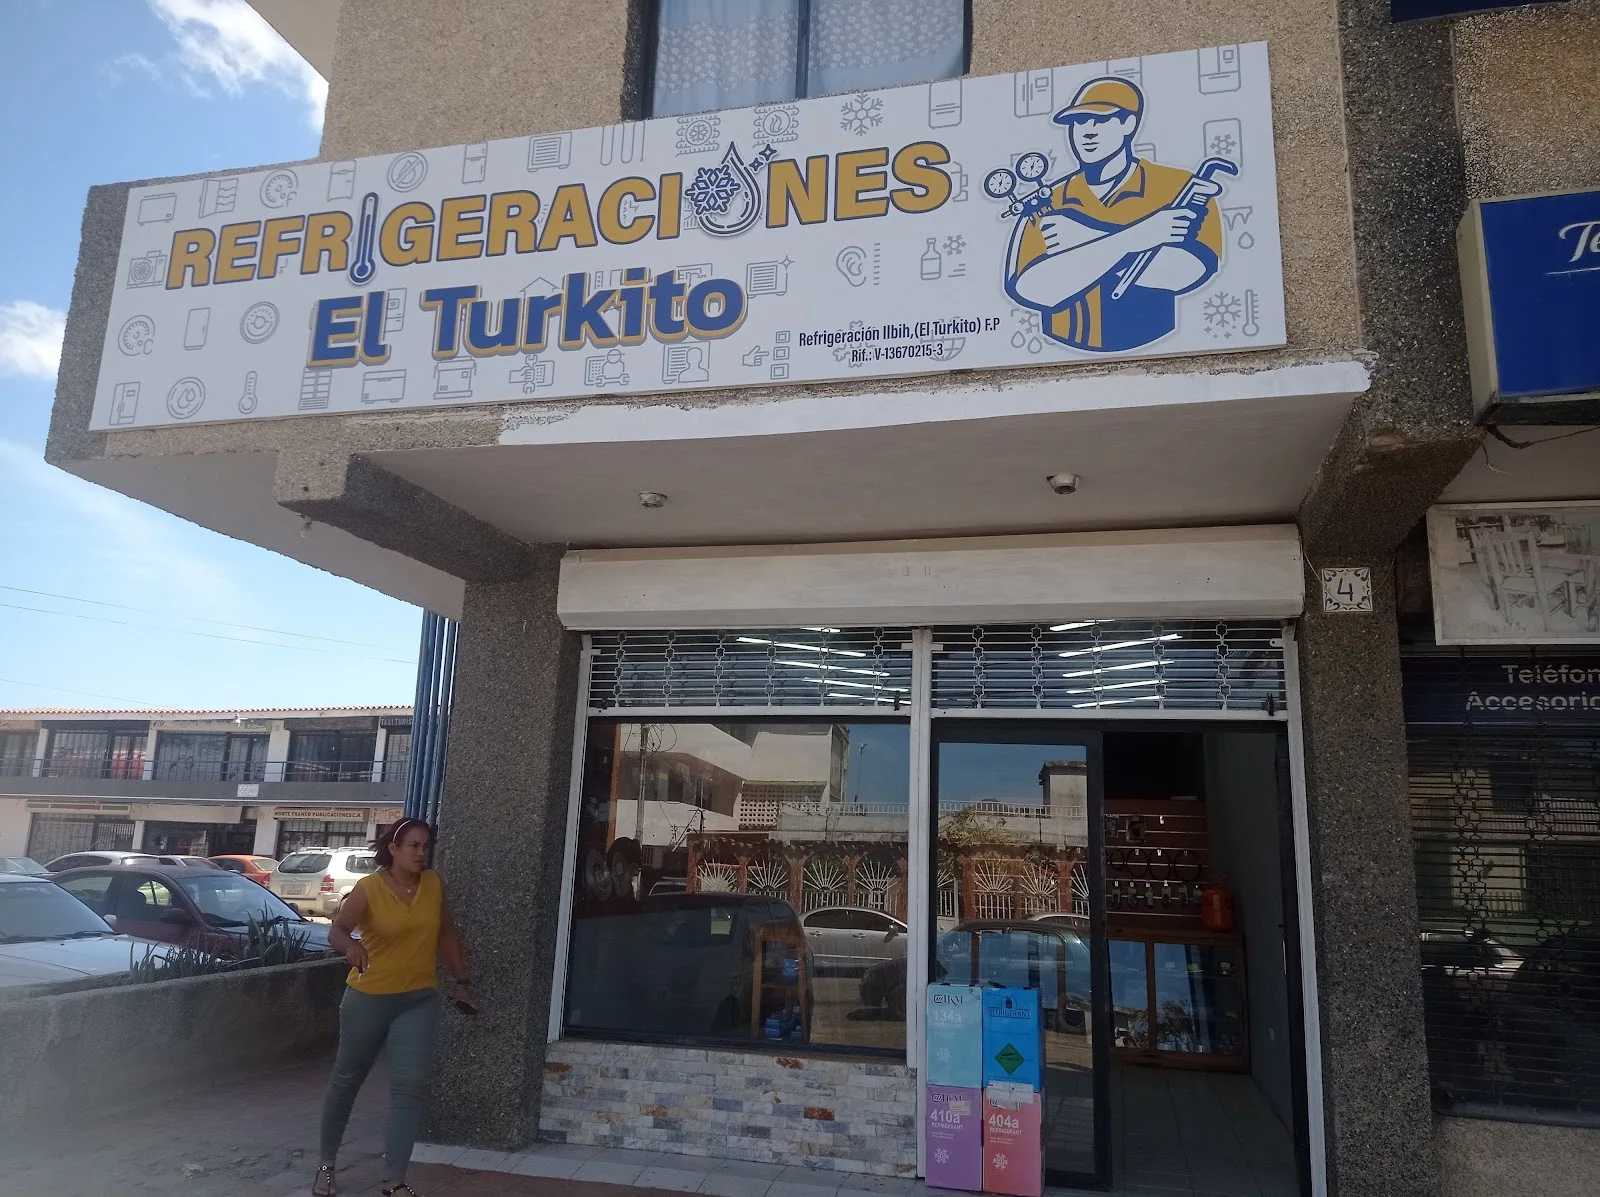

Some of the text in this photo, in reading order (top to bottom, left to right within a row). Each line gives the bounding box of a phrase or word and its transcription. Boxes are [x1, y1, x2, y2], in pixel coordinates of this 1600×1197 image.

[308, 266, 749, 367] El Turkito
[799, 327, 880, 347] Refrigeración
[933, 317, 982, 335] Turkito)
[984, 317, 1001, 332] F.P
[851, 343, 943, 363] Rif.: V-13670215-3
[1337, 577, 1354, 602] 4
[380, 718, 394, 726] TAXI
[930, 1109, 961, 1124] 410a
[989, 1113, 1019, 1129] 404a
[989, 1126, 1022, 1136] REFRIGERANT
